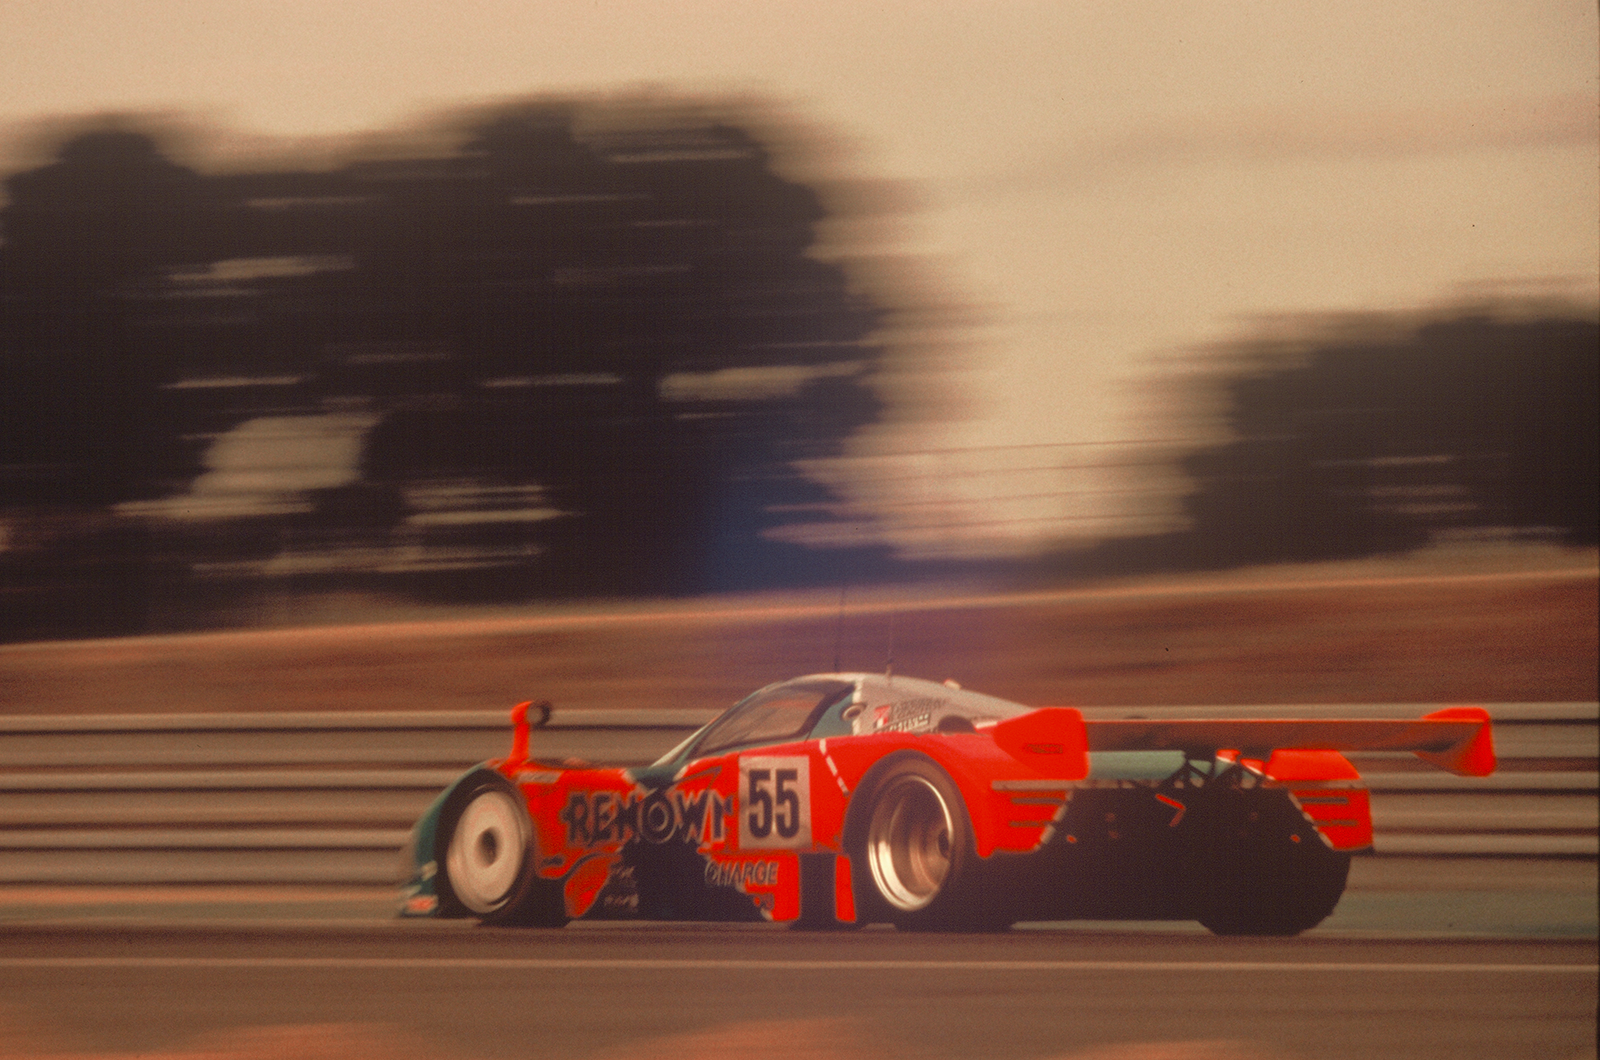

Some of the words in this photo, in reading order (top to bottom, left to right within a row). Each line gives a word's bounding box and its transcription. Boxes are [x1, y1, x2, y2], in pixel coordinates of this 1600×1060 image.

[562, 788, 734, 845] RENOWN
[748, 769, 800, 839] 55
[704, 860, 779, 886] CHARGE
